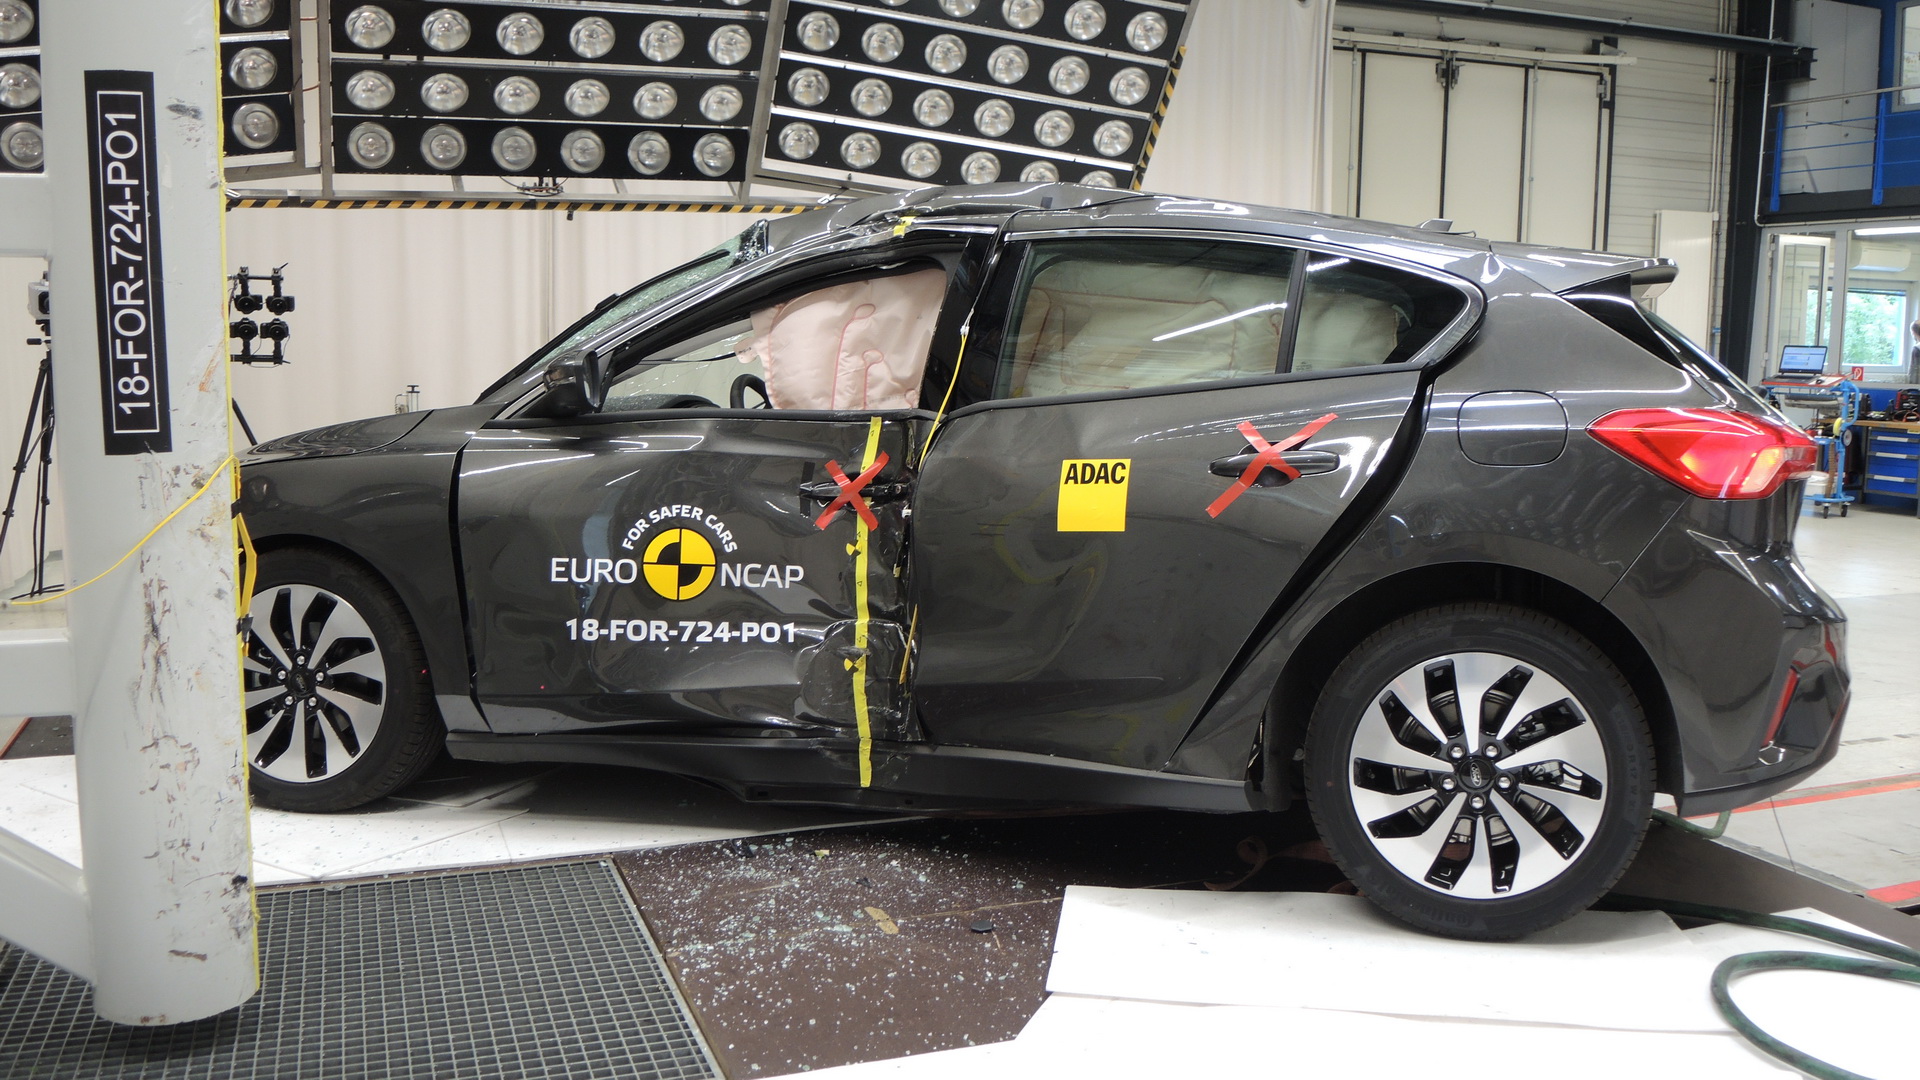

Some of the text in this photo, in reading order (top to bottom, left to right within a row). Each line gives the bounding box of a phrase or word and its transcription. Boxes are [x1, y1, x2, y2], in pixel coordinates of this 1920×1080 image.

[1064, 462, 1127, 485] ADAC
[621, 504, 738, 553] FOR SAFER CARS
[551, 557, 805, 589] EURO NCAP
